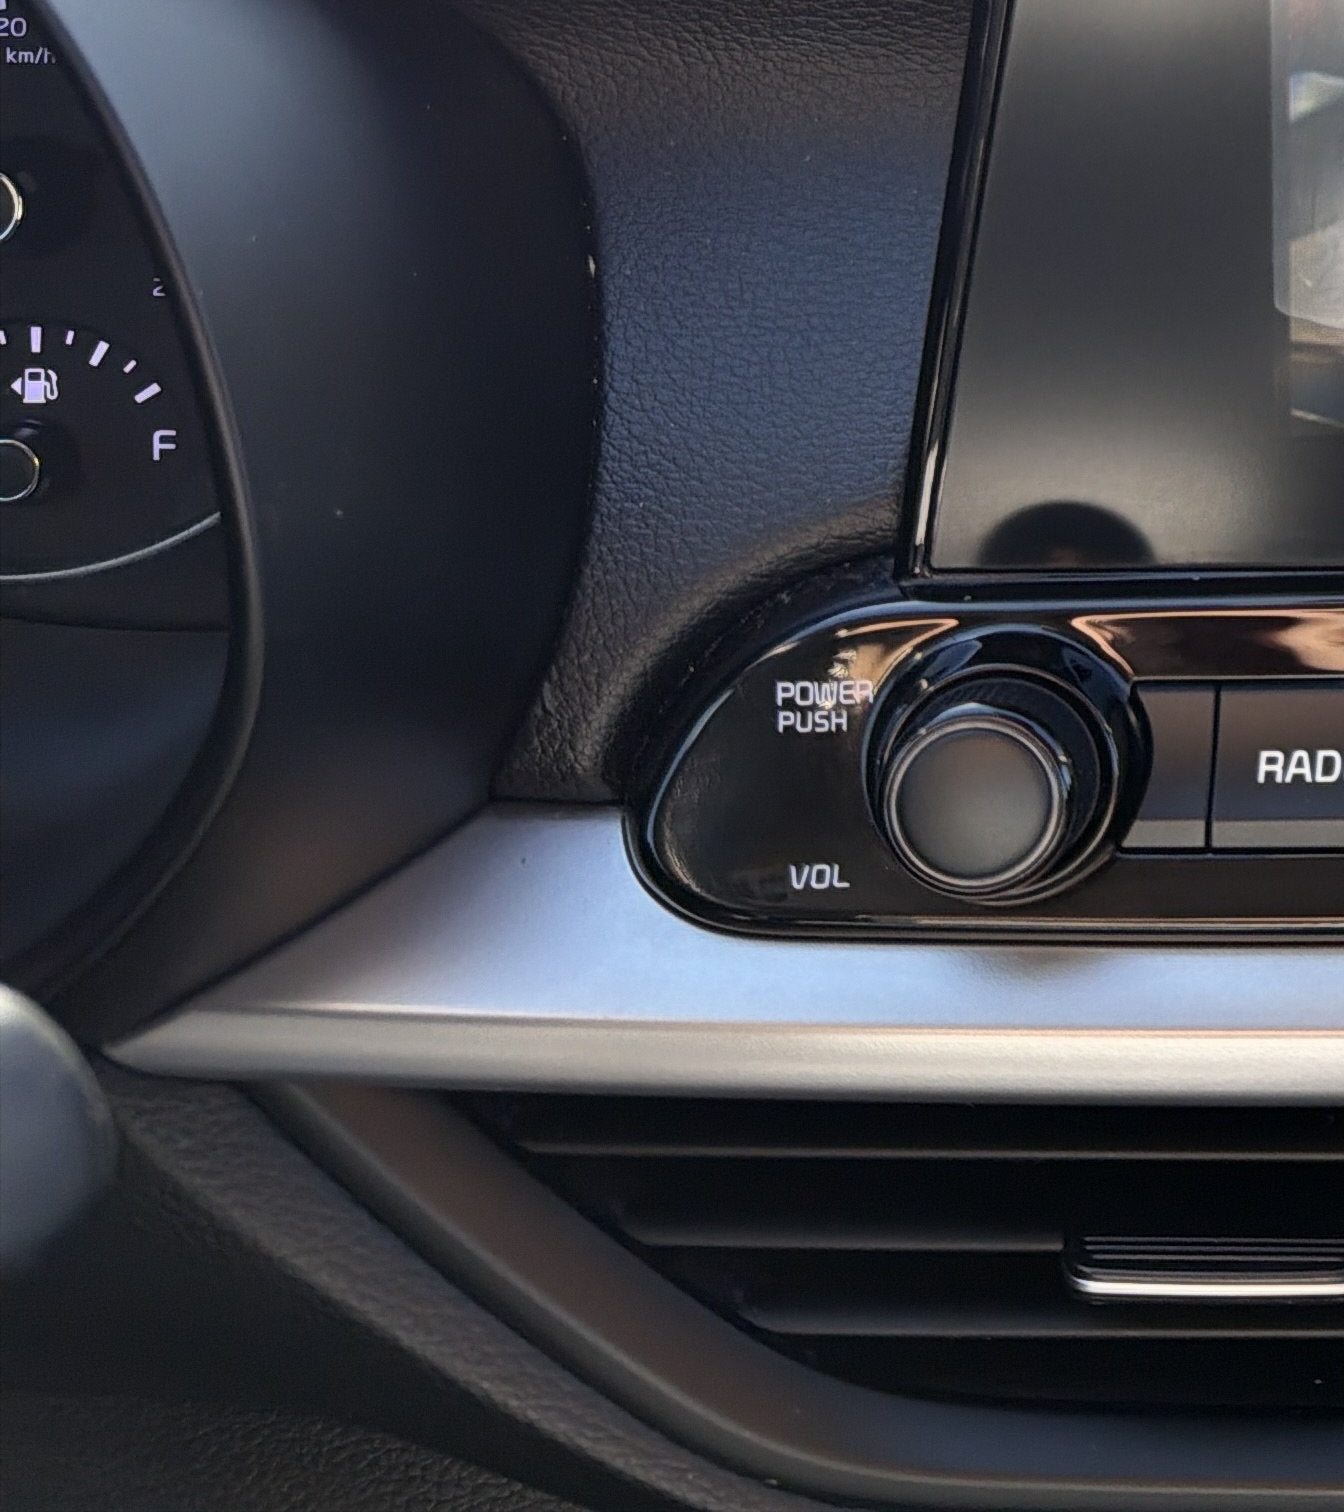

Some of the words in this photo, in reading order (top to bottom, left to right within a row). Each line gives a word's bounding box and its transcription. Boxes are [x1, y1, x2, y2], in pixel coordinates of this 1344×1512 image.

[6, 46, 56, 64] km/h
[152, 429, 177, 461] F
[776, 680, 874, 707] POWER
[778, 710, 849, 734] PUSH
[789, 863, 850, 890] VOL
